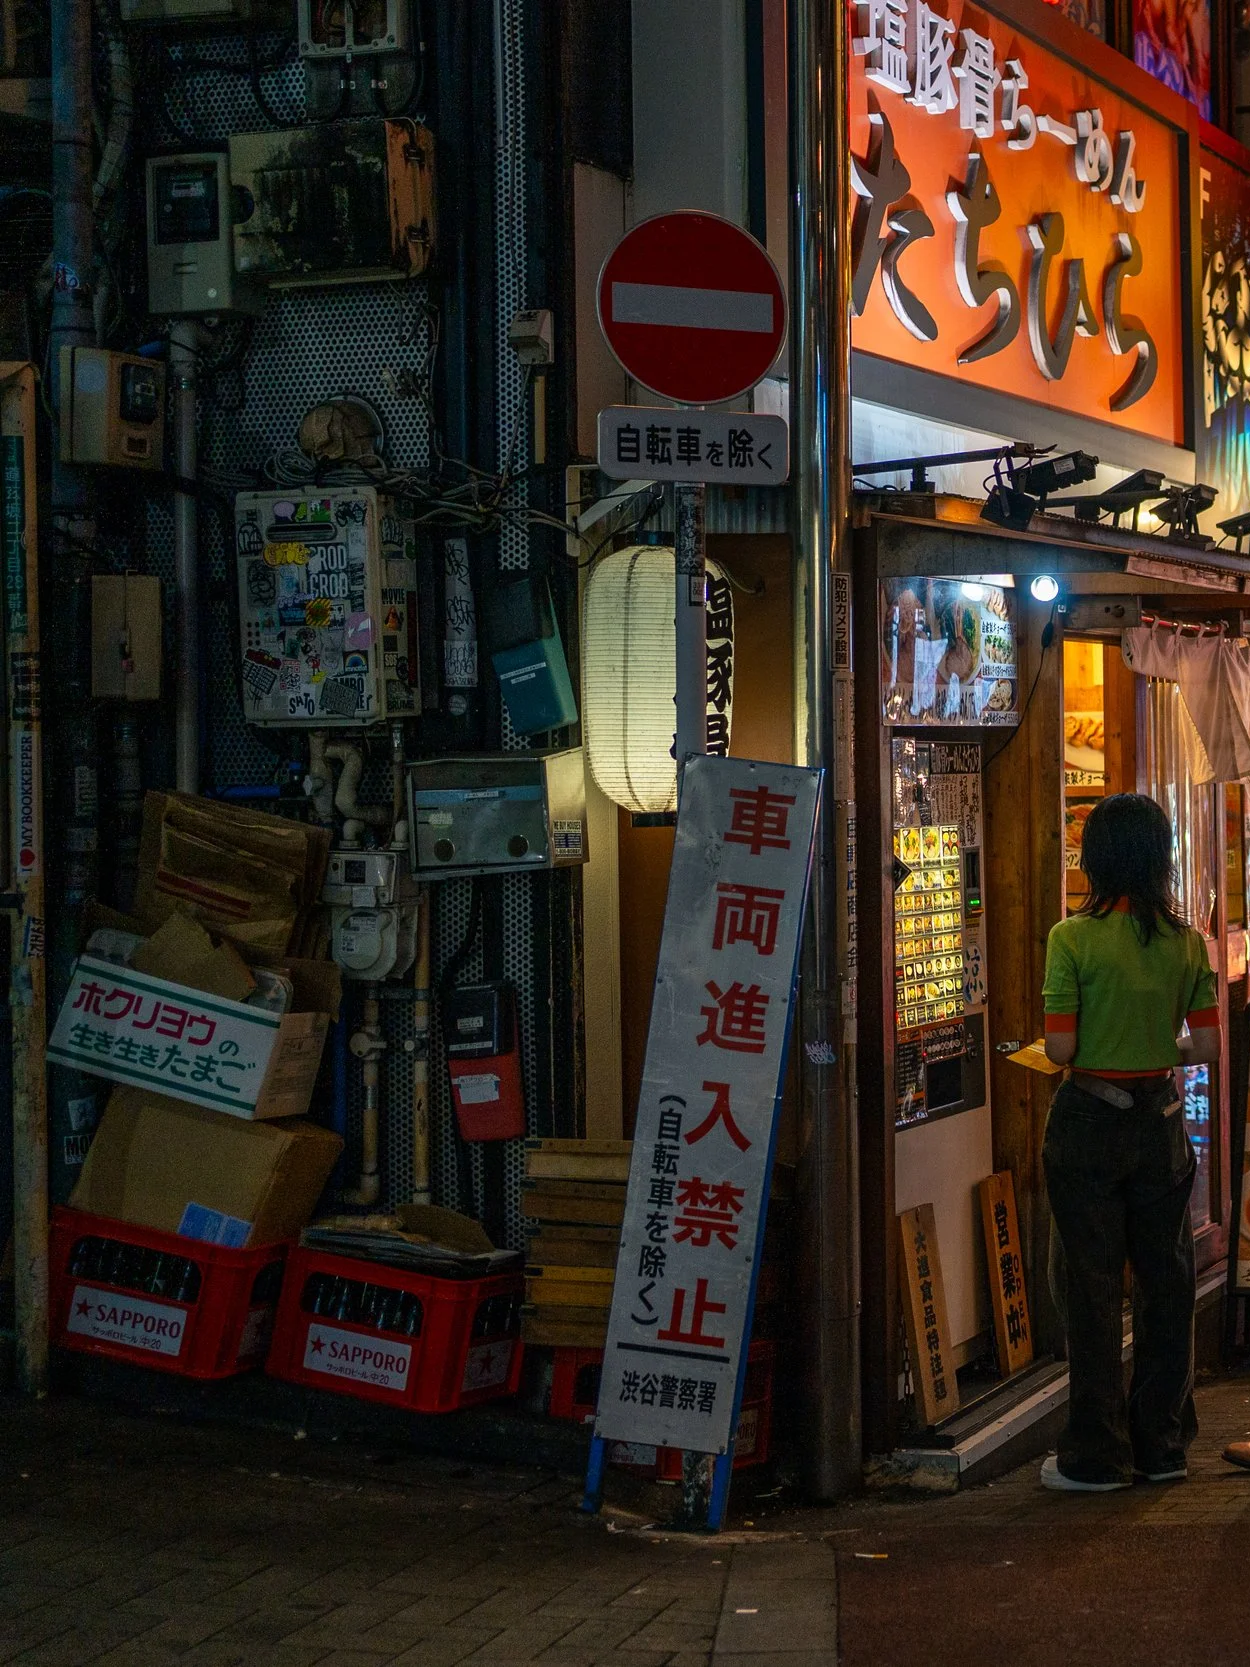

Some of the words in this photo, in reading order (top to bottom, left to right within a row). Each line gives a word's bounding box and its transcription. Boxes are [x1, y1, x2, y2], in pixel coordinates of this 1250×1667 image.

[617, 423, 773, 470] 自転車を除く
[835, 577, 848, 665] 防犯カメラ設置
[21, 735, 33, 825] BOOKKEEPER
[69, 1022, 256, 1093] 生き生きたまご
[657, 786, 797, 1350] 車両進入禁止
[994, 1200, 1021, 1350] 営業中
[95, 1303, 181, 1339] SAPPORO
[328, 1341, 407, 1374] SAPPORO
[618, 1370, 718, 1414] 渋谷警察署
